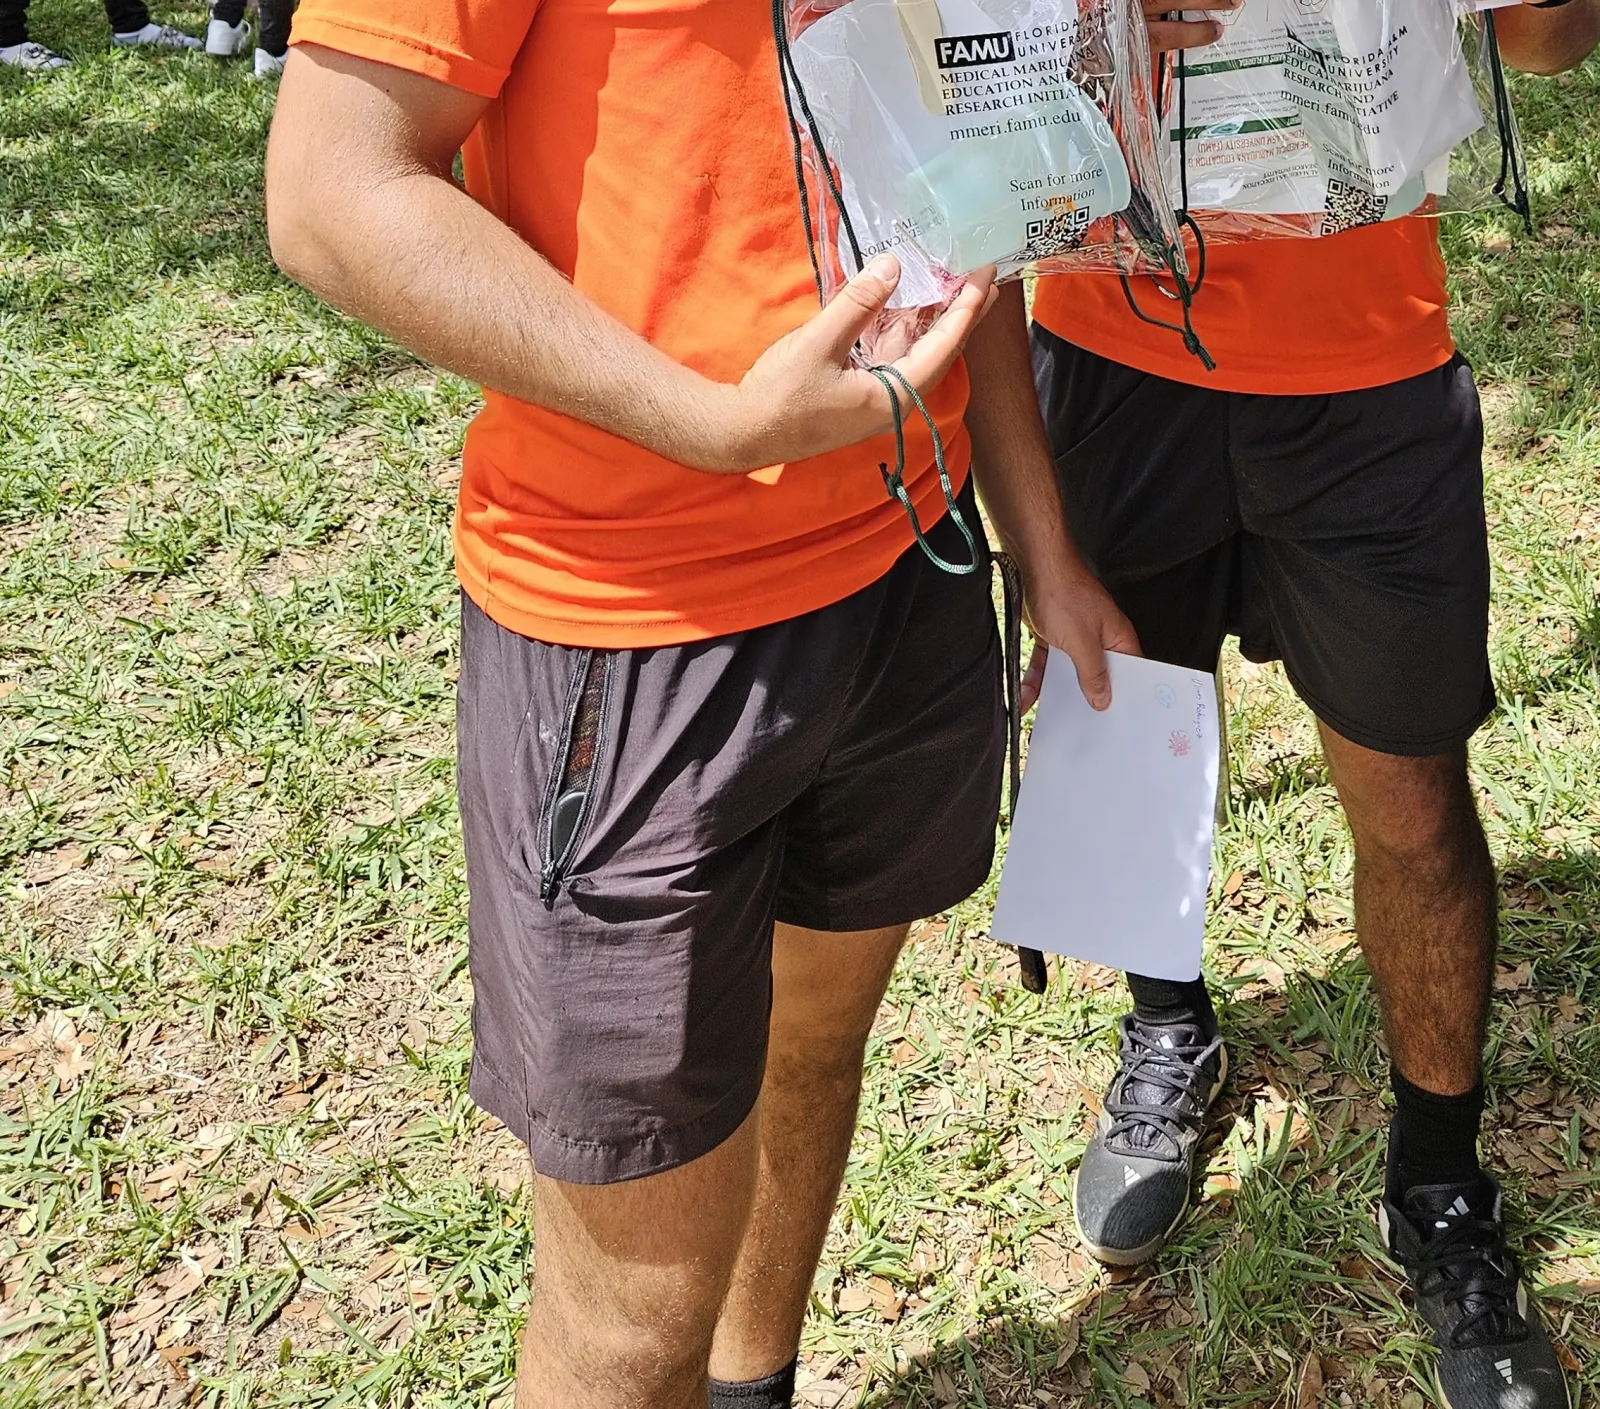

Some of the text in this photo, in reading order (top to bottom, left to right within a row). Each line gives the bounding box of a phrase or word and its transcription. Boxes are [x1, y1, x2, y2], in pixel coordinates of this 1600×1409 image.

[940, 37, 1010, 65] FAMU
[1015, 18, 1080, 42] FLORIDA
[1018, 25, 1100, 58] UNIVERSITY
[940, 47, 1095, 85] MEDICAL MARIJUANA
[1325, 48, 1384, 66] FLORIDA
[1328, 45, 1399, 78] UNIVERSITY
[942, 71, 1072, 100] EDUCATION AND
[945, 77, 1105, 116] RESEARCH INITIATIVE
[1283, 67, 1342, 99] RESEARCH
[950, 110, 1081, 141] mmeri.famu.edu
[1198, 141, 1222, 153] (FAMU)
[1226, 137, 1265, 151] UNIVERSITY
[1196, 154, 1234, 167] EDUCATION
[1365, 164, 1395, 176] more
[1010, 168, 1103, 193] Scan for more
[1021, 187, 1095, 211] Information
